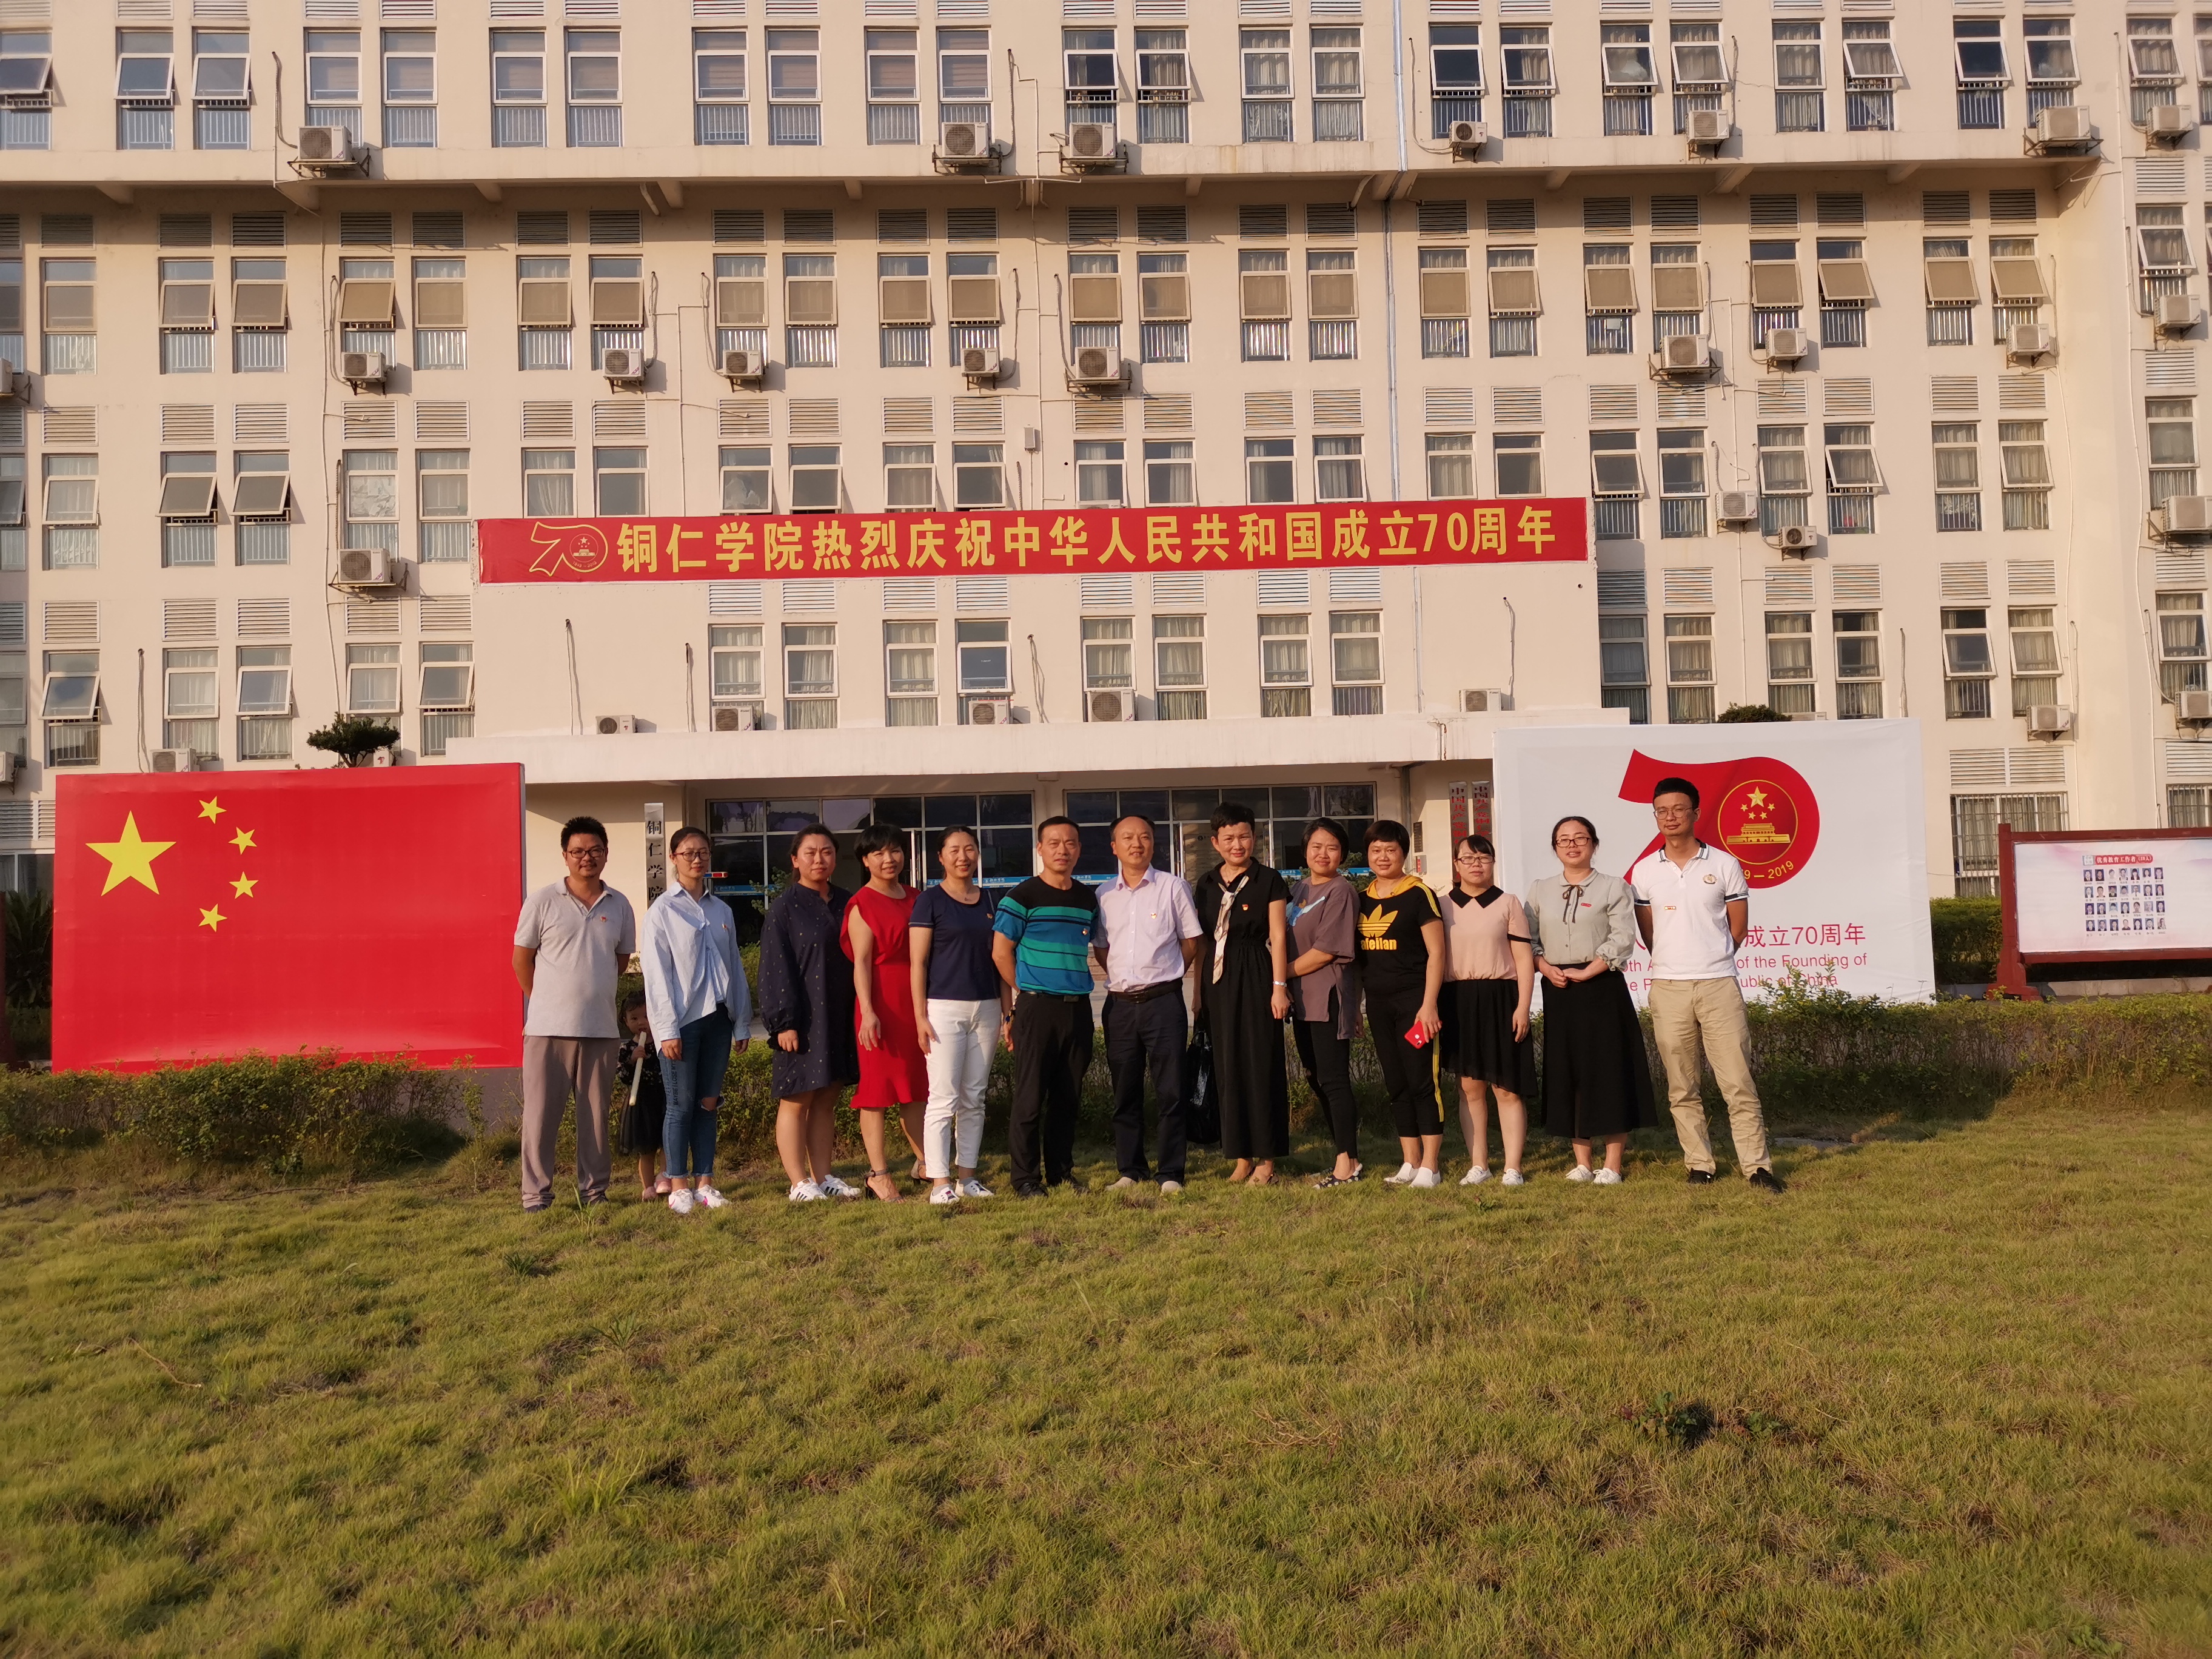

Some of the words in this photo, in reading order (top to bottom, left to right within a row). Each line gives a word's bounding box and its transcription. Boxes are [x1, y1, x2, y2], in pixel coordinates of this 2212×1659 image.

[617, 505, 1556, 574] 铜仁学院热烈庆祝中华人民共和国成立70周年
[646, 820, 664, 901] 铜仁学院
[1736, 956, 1749, 969] of
[1754, 955, 1777, 968] the
[1782, 953, 1848, 970] Founding
[1854, 953, 1868, 966] of
[1740, 974, 1772, 988] ublic
